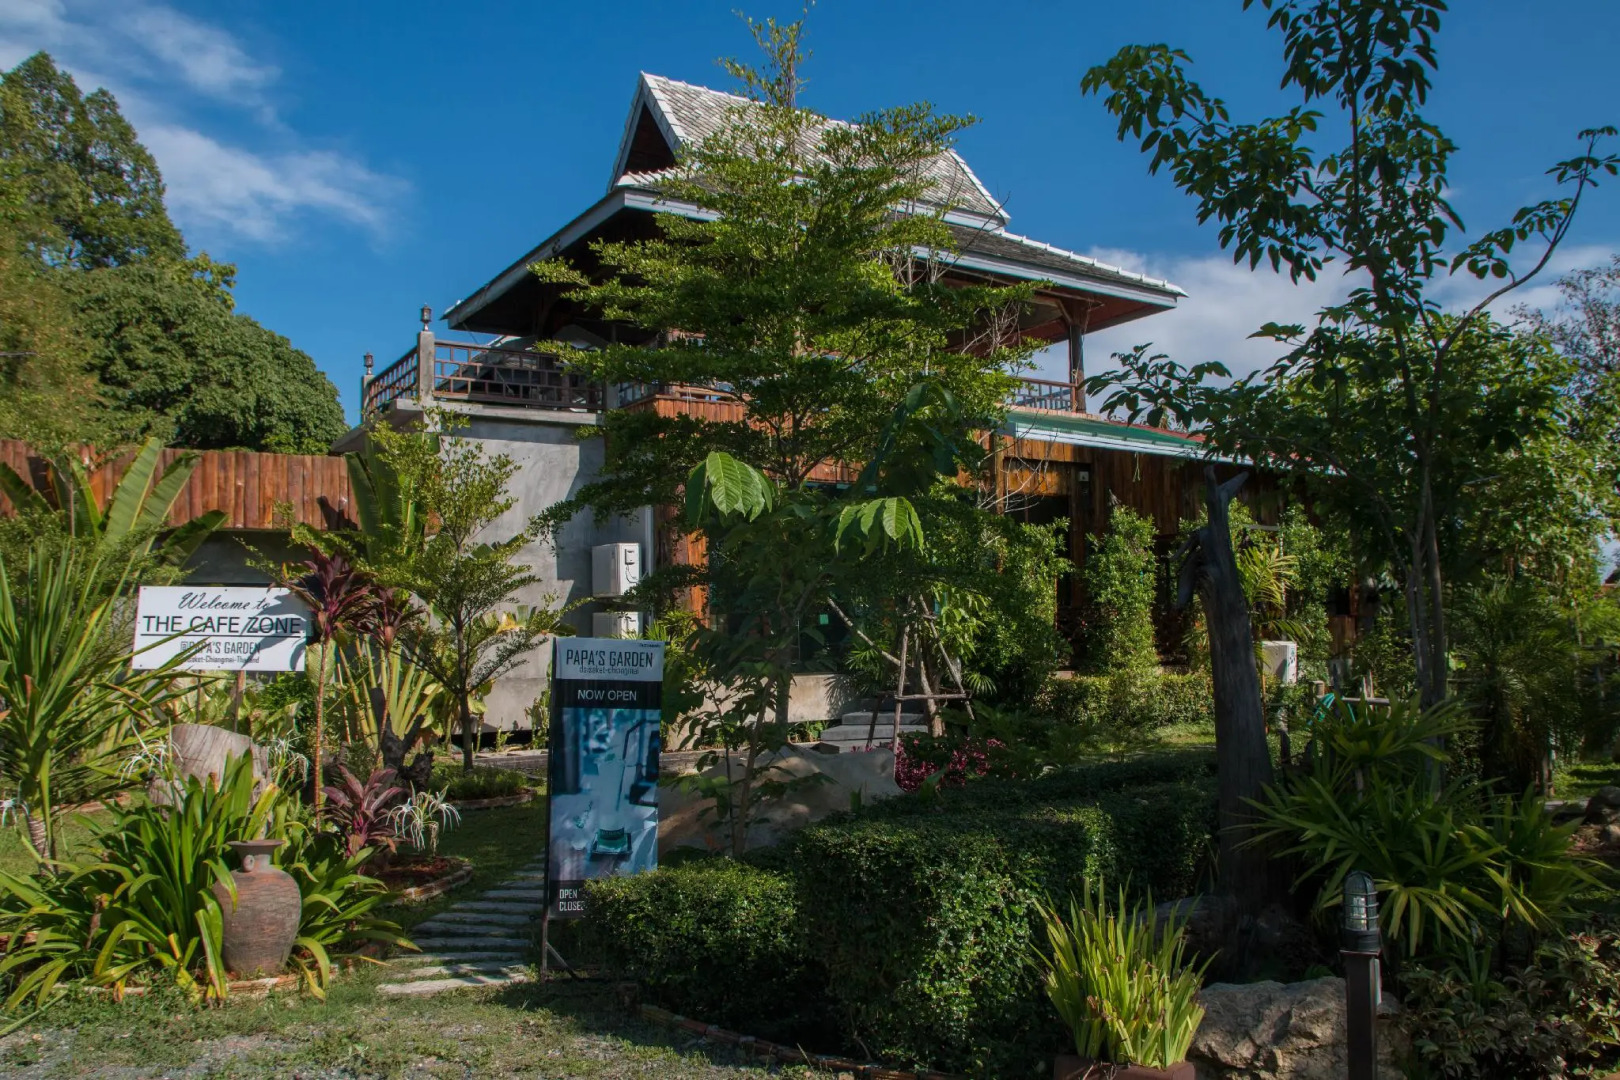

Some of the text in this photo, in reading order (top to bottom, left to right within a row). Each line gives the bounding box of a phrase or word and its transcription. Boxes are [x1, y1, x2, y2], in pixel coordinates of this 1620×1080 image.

[178, 592, 271, 610] Welcome to
[143, 615, 301, 634] THE CAFE ZONE
[224, 641, 261, 655] GARDEN
[566, 649, 653, 668] PAPA'S GARDEN
[577, 689, 637, 702] NOW OPEN
[559, 888, 578, 899] OPEN
